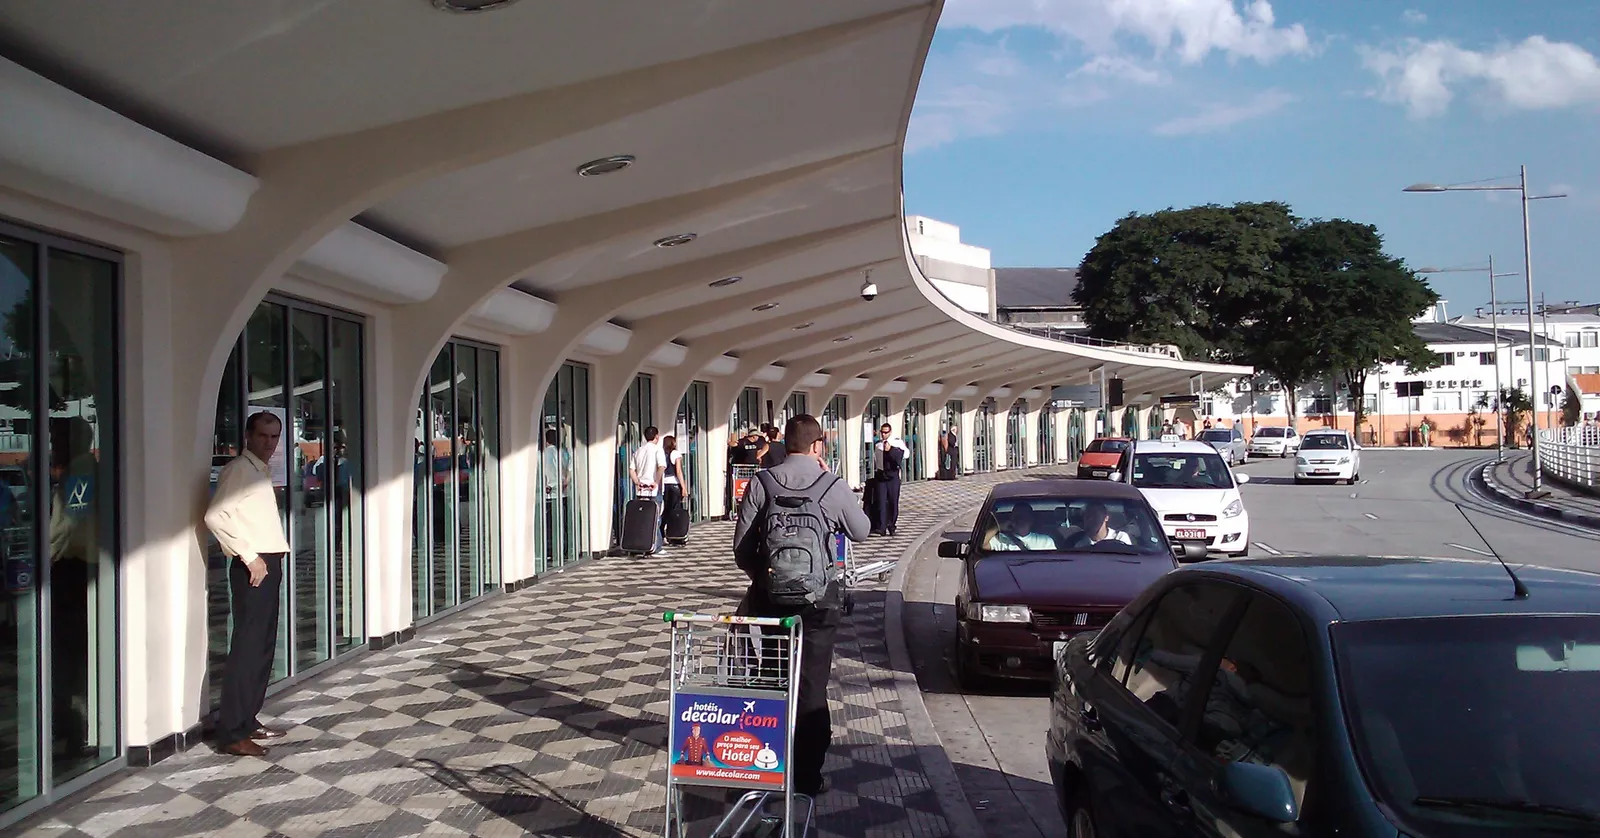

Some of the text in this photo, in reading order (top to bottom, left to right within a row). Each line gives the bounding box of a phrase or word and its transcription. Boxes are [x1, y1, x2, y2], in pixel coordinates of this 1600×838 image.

[693, 701, 719, 712] hotéis
[721, 749, 754, 762] Hotel
[695, 769, 760, 780] www.decolar.com
